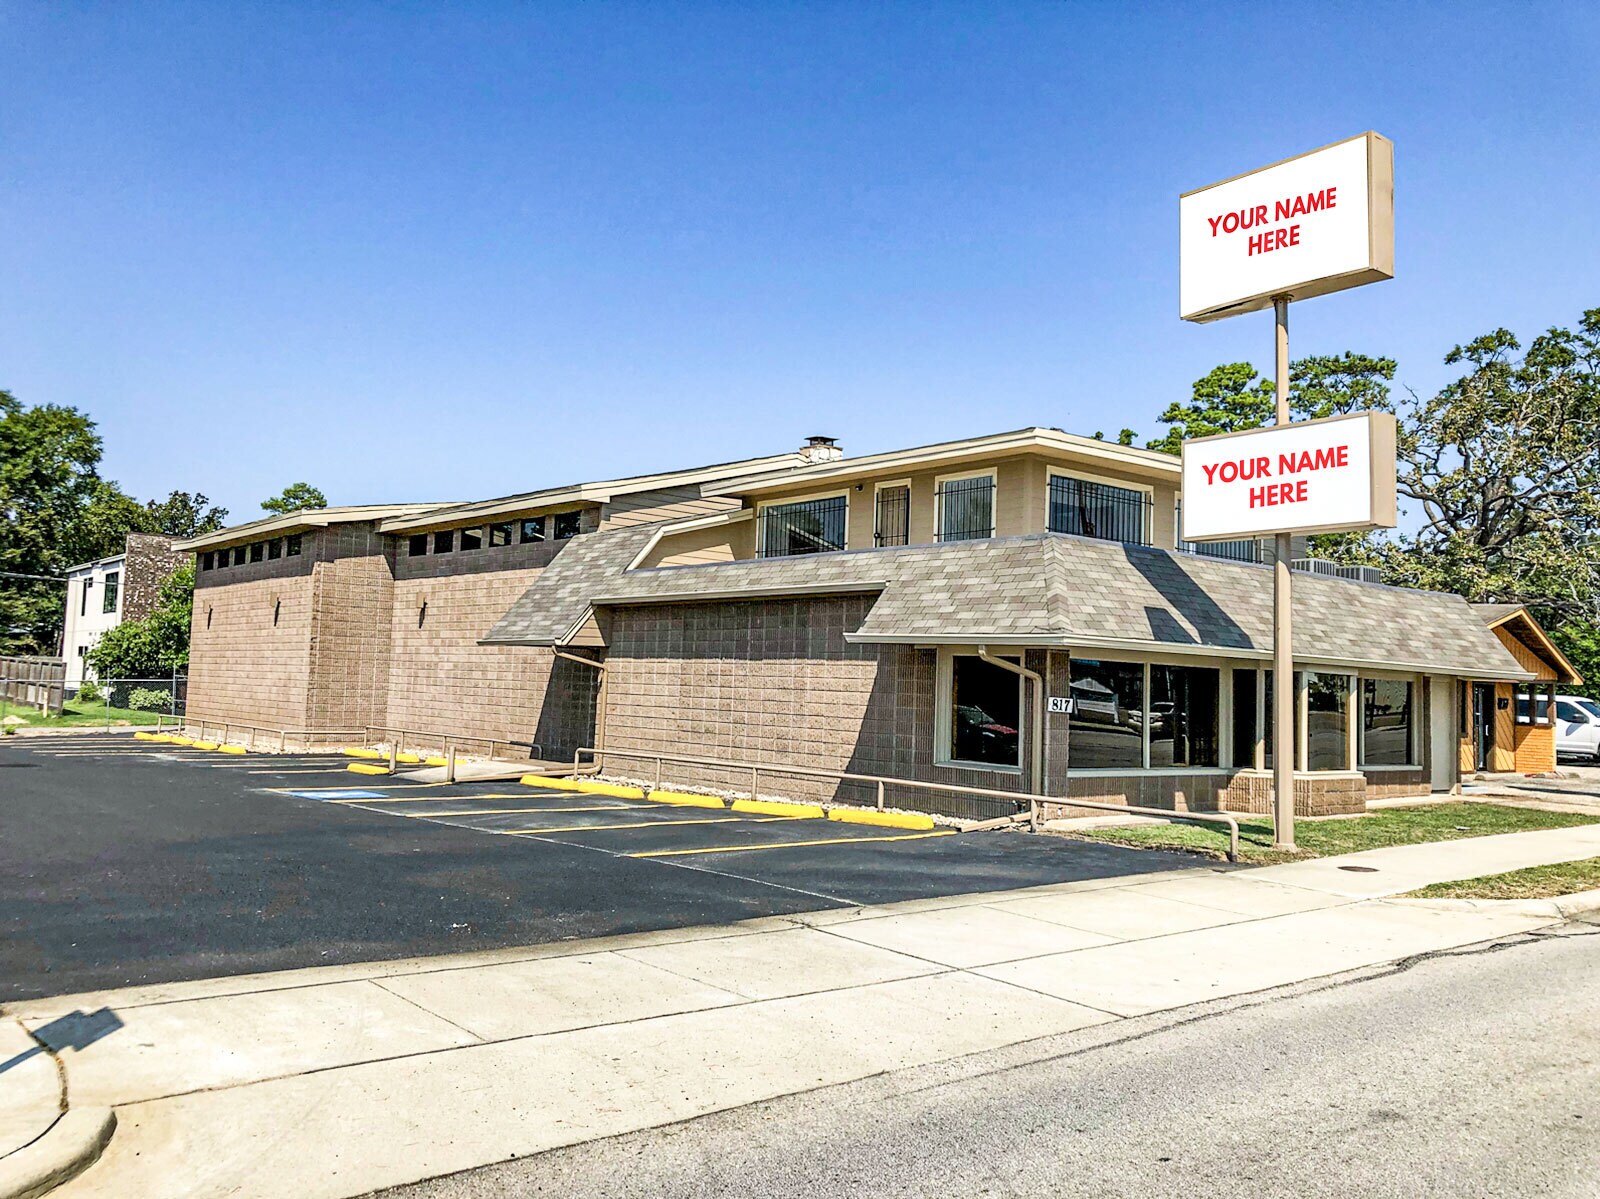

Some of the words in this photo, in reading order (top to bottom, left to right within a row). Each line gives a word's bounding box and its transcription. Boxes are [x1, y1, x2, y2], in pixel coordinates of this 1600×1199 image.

[1207, 204, 1269, 238] YOUR
[1274, 186, 1337, 222] NAME
[1248, 224, 1301, 257] HERE
[1201, 456, 1272, 486] YOUR
[1278, 445, 1349, 476] NAME
[1249, 479, 1308, 509] HERE
[1052, 698, 1071, 712] 817
